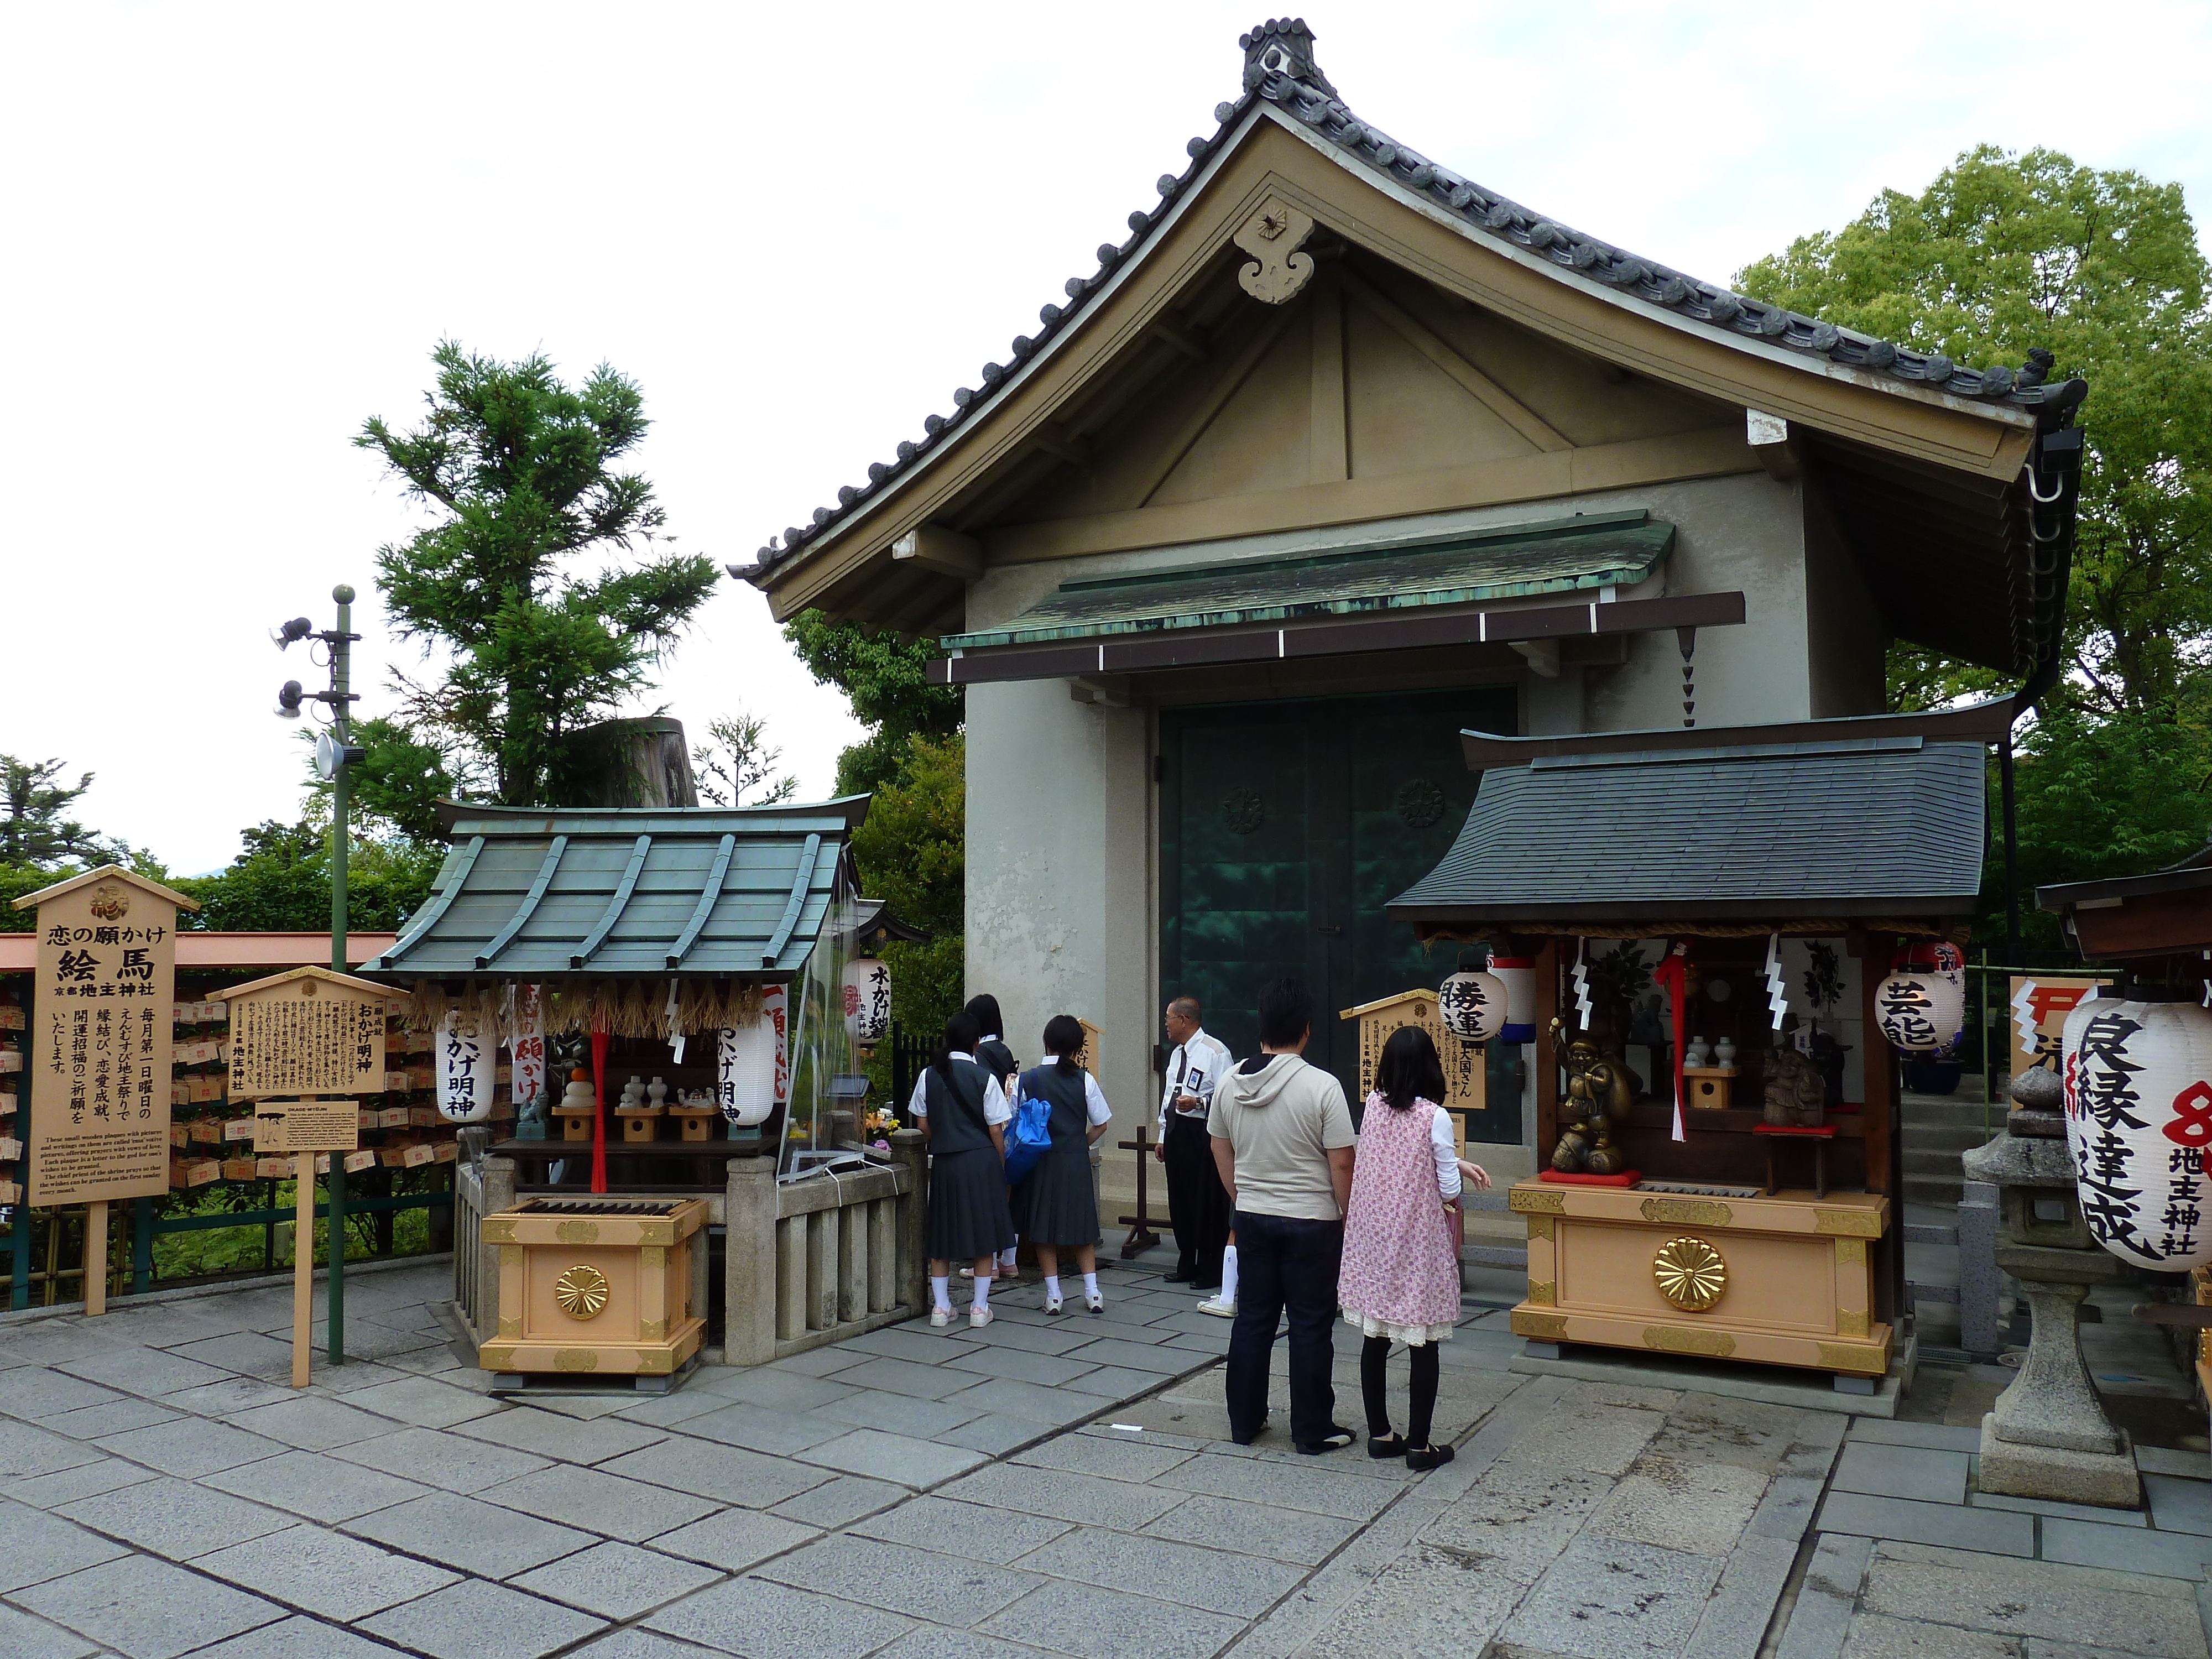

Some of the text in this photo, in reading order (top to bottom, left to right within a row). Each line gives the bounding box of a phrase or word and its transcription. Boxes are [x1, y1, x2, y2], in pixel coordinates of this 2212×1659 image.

[46, 925, 166, 946] 恋の願かけ
[56, 948, 155, 982] 絵馬
[54, 982, 155, 997] 京都地主神社
[374, 1000, 384, 1036] 一願成就
[1439, 981, 1490, 1038] 勝運
[1880, 981, 1937, 1045] 芸能
[50, 1013, 66, 1074] いたします。
[70, 1010, 88, 1124] 開運招福のご祈願を
[94, 1009, 112, 1122] 縁結び、恋愛成就、
[117, 1008, 133, 1120] えんむすび地主祭りで
[139, 1008, 155, 1119] 毎月第一日曜日の
[232, 1030, 245, 1091] 京都地主神社
[356, 1004, 373, 1073] おかげ明神
[1363, 1044, 1371, 1097] 京都地主神社
[1459, 1047, 1472, 1097] 大国さん
[2077, 1013, 2166, 1261] 良縁達成
[2158, 1147, 2204, 1256] 地主神社
